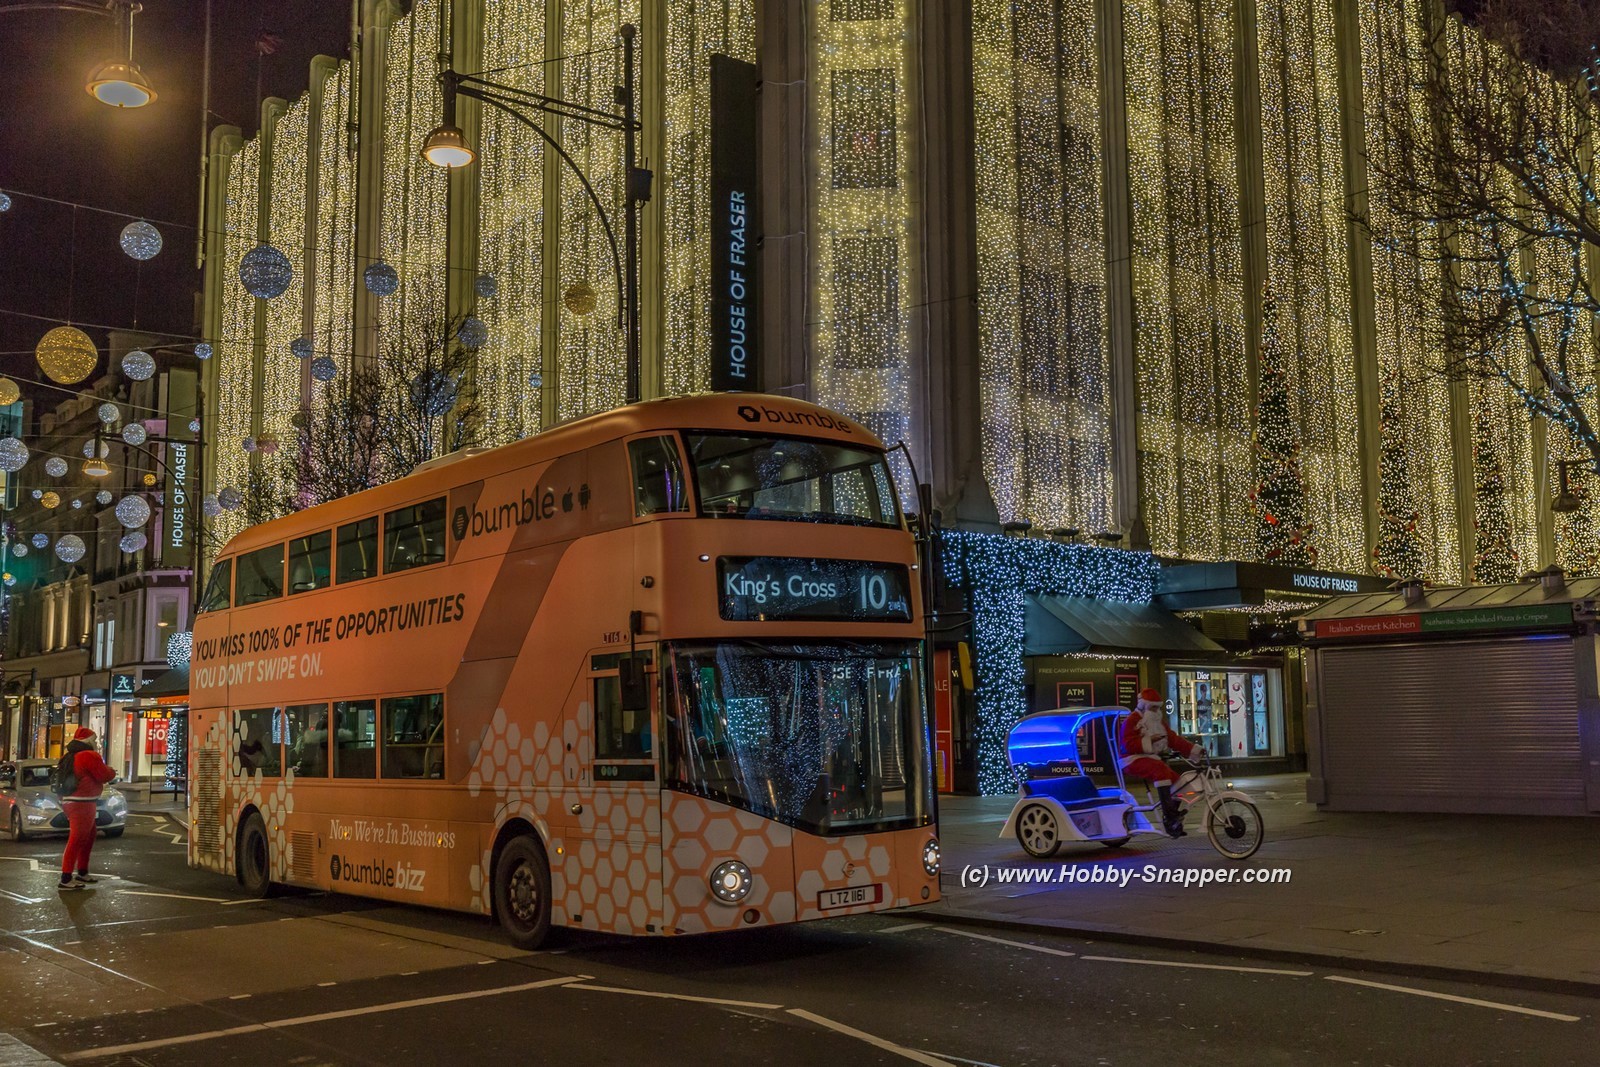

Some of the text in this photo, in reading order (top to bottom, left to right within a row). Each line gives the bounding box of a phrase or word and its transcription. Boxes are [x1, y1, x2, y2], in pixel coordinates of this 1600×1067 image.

[730, 190, 746, 378] HOUSE OF FRASER
[760, 405, 852, 434] bumble
[172, 443, 187, 547] HOUSE OF FRASER
[471, 484, 555, 537] bumble
[725, 572, 886, 610] King's Cross 10
[1293, 574, 1358, 592] HOUSE OF FRASER
[195, 592, 466, 661] YOU MISS 100% OF THE OPPORTUNITIES
[1329, 618, 1416, 633] Italian Street Kitchen
[194, 652, 324, 690] YOU DON'T SWIPE ON.
[1196, 672, 1210, 680] Dior
[1066, 688, 1085, 696] ATM
[1051, 766, 1073, 774] HOUSE
[1084, 766, 1105, 774] FRASER
[329, 819, 456, 849] Now We're In Business
[830, 889, 866, 905] LTZ 1161
